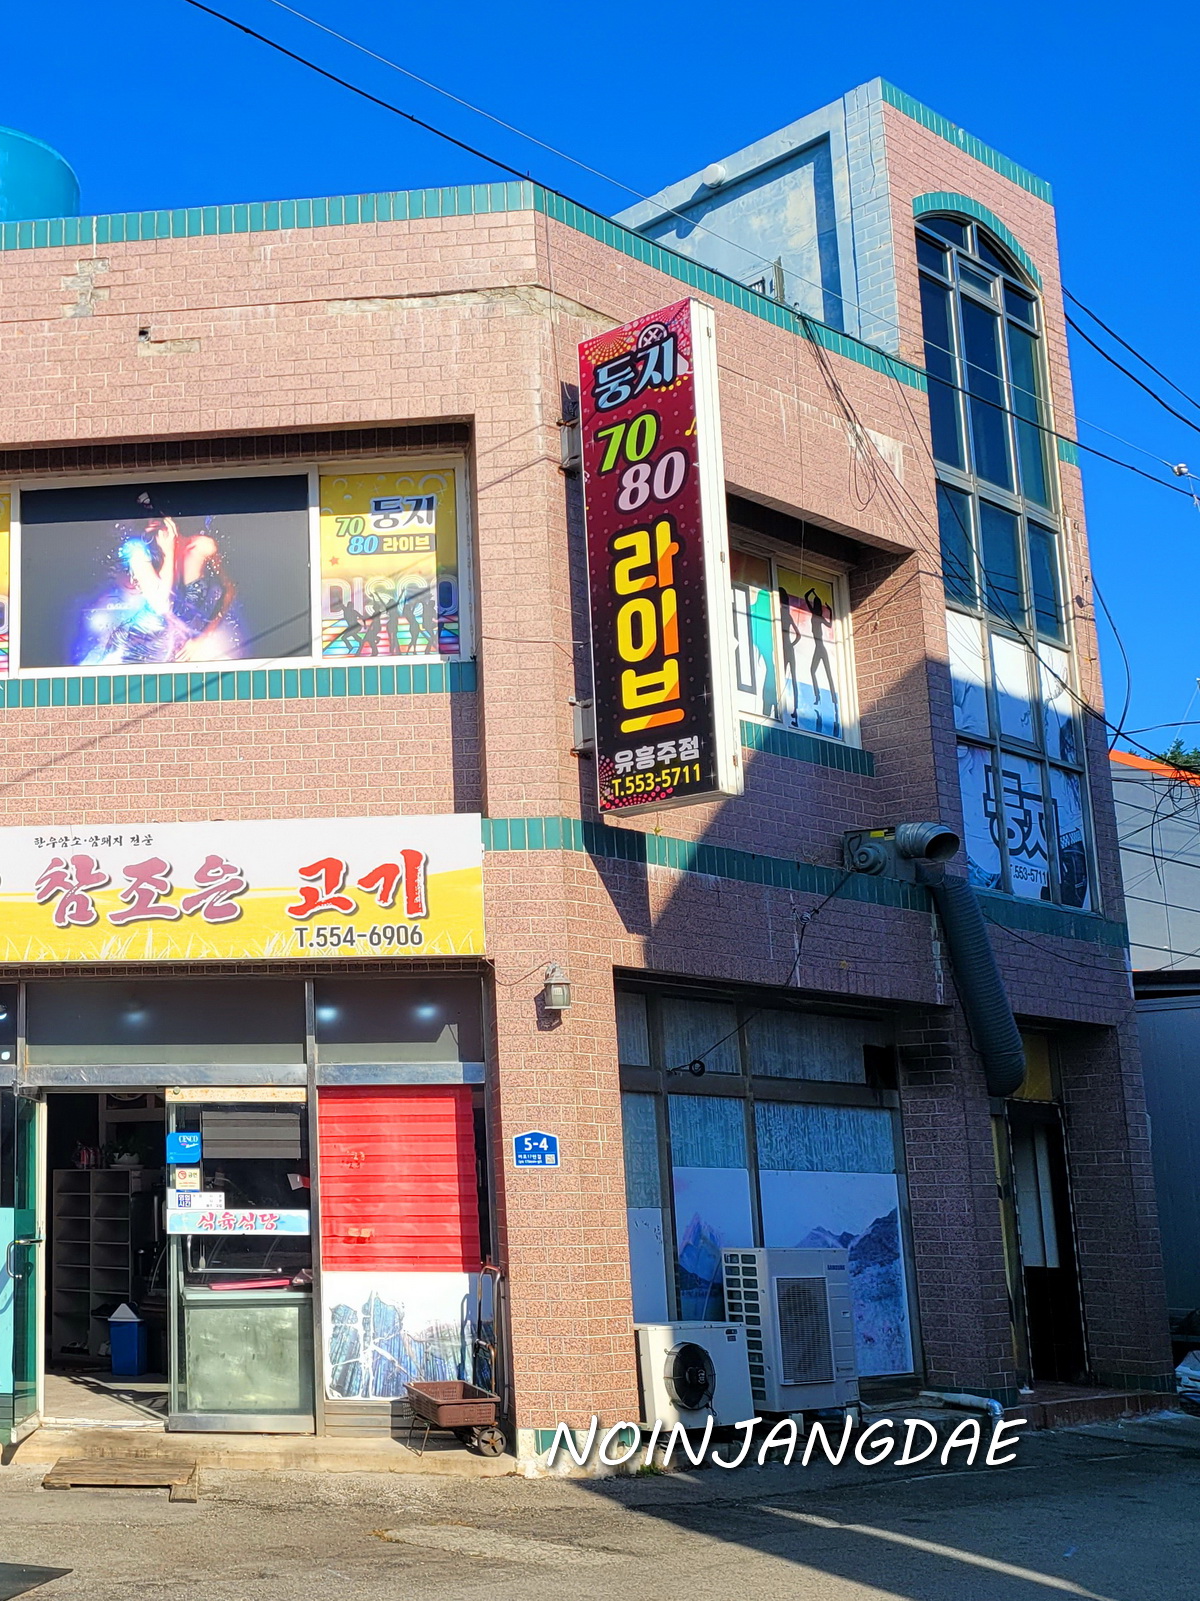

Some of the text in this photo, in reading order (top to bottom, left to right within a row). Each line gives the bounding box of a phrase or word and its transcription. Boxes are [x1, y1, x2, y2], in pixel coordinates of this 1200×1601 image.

[594, 336, 679, 409] 둥지
[599, 414, 658, 474] 70
[618, 450, 686, 512] 80
[335, 516, 365, 537] 70
[372, 494, 436, 530] 둥지
[347, 534, 431, 555] 80 라이브
[320, 574, 458, 620] DISCO
[613, 520, 685, 734] 라이브
[614, 735, 700, 775] 유흥주점
[611, 762, 701, 797] T.553-5711
[130, 834, 154, 847] 전문
[34, 848, 427, 927] 참조은 고기
[1009, 864, 1047, 885] .553-5711
[295, 924, 424, 949] T.554-6906
[524, 1137, 549, 1151] 5-4
[197, 1212, 279, 1230] 식육식당
